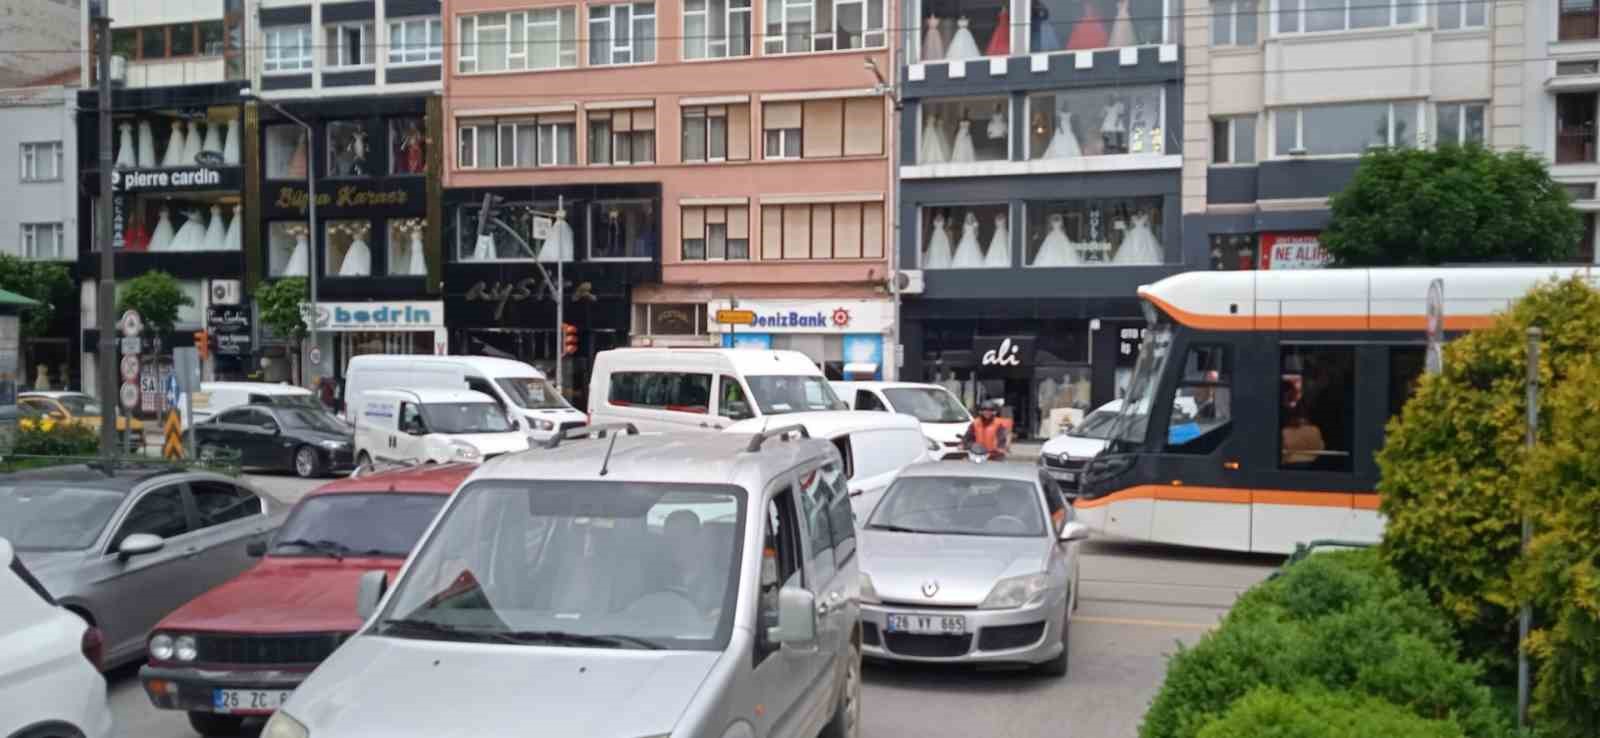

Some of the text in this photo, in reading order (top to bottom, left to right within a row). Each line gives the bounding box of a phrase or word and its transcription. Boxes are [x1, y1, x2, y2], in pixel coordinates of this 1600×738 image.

[125, 170, 169, 190] pierre
[171, 168, 219, 185] cardin
[1275, 246, 1293, 261] NE
[751, 313, 827, 329] DenizBank
[982, 338, 1021, 366] ali
[250, 692, 267, 708] ZC
